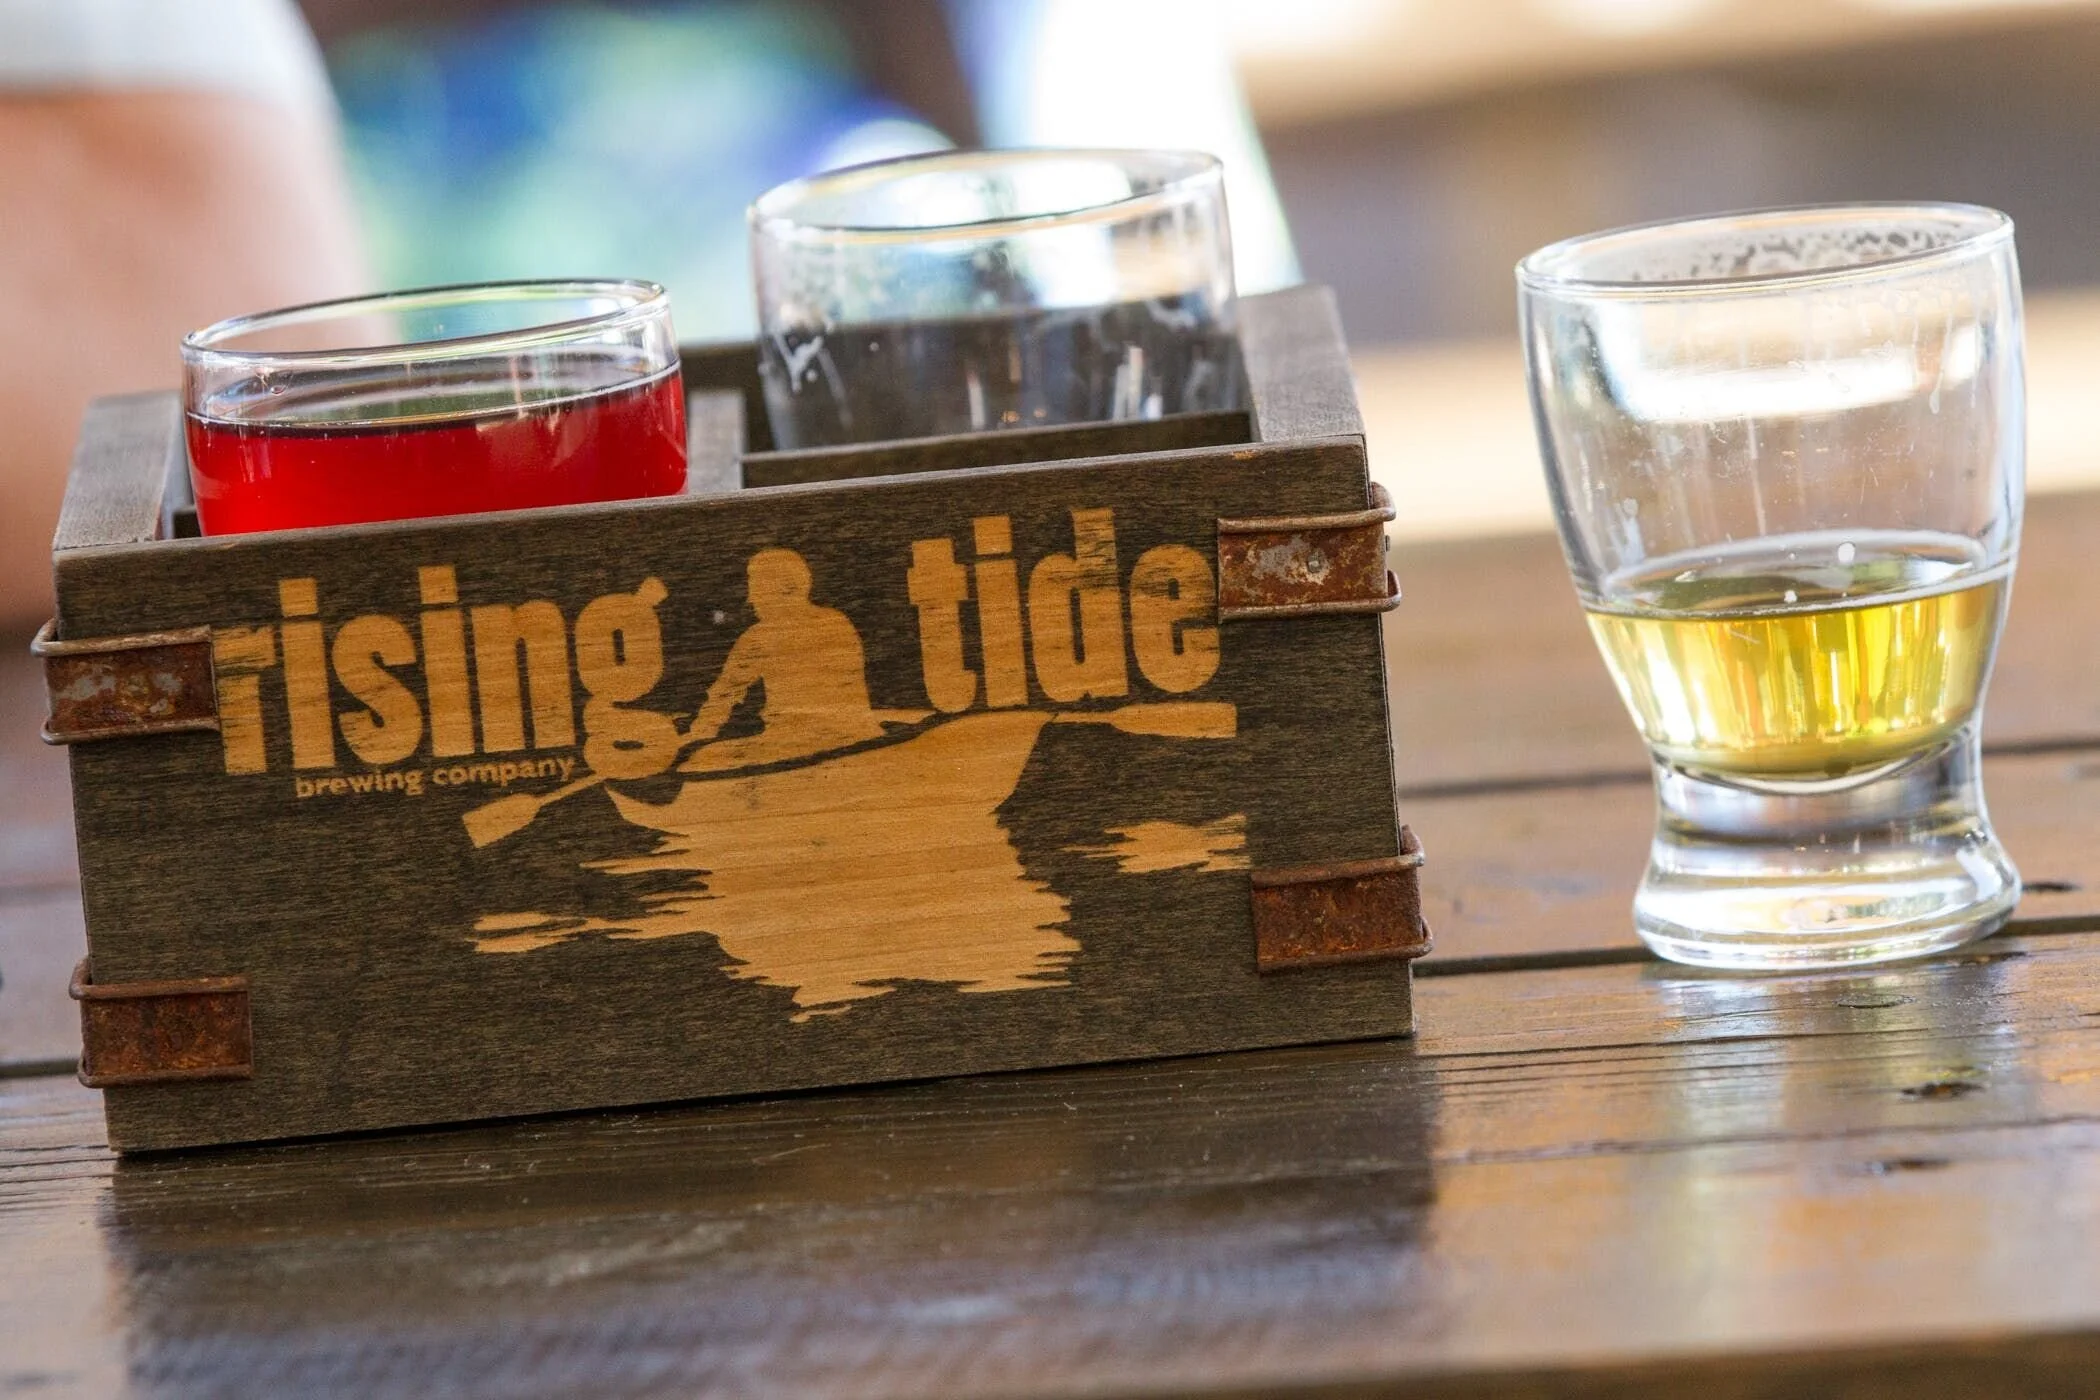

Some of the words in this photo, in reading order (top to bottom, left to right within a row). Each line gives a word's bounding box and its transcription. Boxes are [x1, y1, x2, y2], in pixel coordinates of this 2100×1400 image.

[213, 564, 680, 780] rising
[906, 507, 1221, 713] tide
[295, 768, 424, 798] brewing
[432, 756, 575, 787] company
